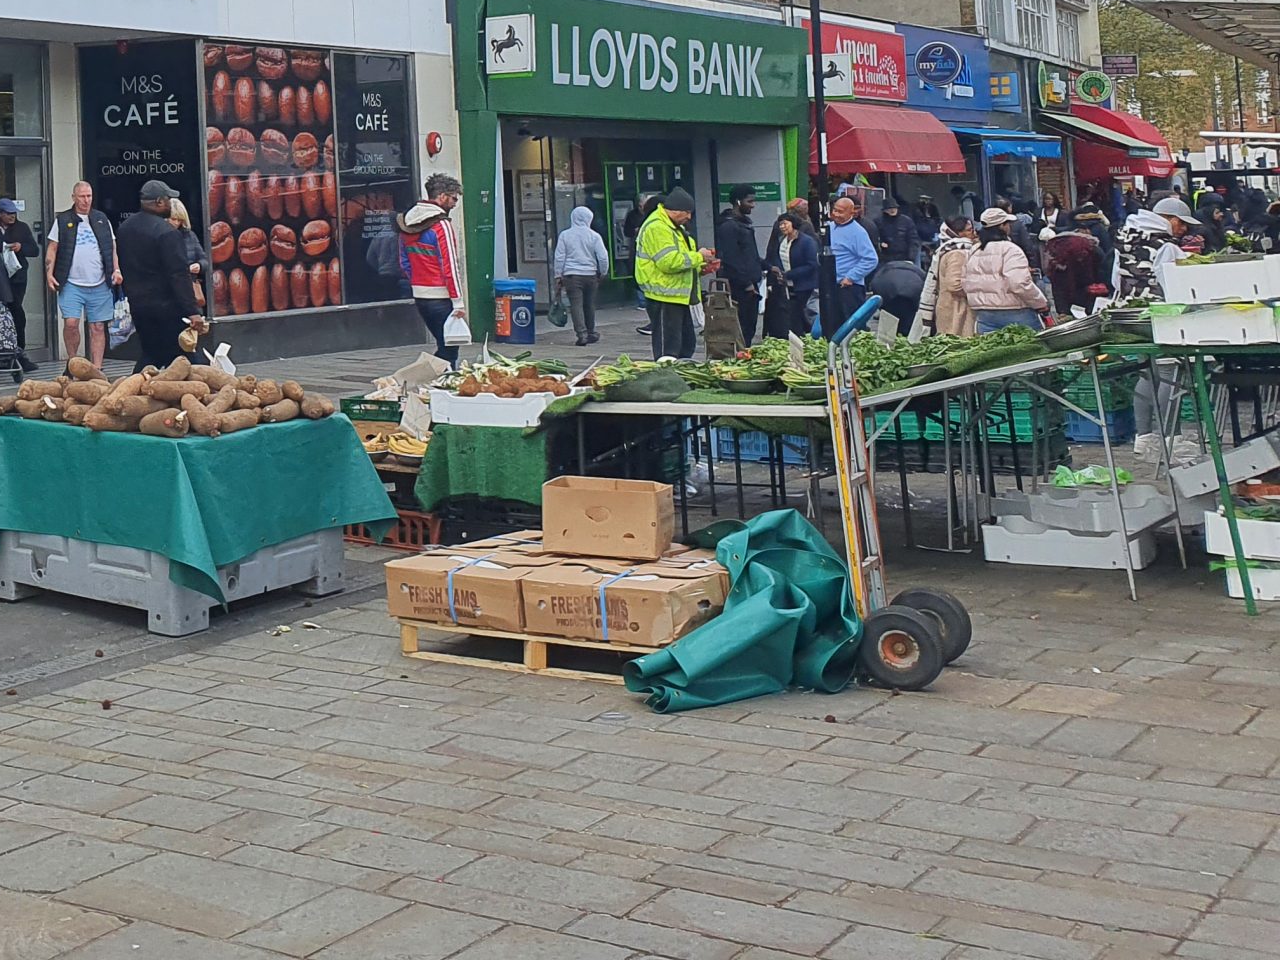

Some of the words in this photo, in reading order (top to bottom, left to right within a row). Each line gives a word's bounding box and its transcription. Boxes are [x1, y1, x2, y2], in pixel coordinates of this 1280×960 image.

[551, 23, 679, 93] LLOYDS
[688, 39, 765, 98] BANK
[121, 74, 163, 94] M&S
[104, 93, 180, 127] CAFÉ
[362, 92, 382, 108] M&S
[355, 108, 389, 131] CAFÉ
[122, 150, 140, 161] ON
[142, 149, 162, 160] THE
[101, 164, 147, 176] GROUND
[149, 162, 185, 174] FLOOR
[1108, 166, 1132, 174] HALAL
[408, 585, 443, 605] FRESH
[550, 595, 592, 616] FRESH
